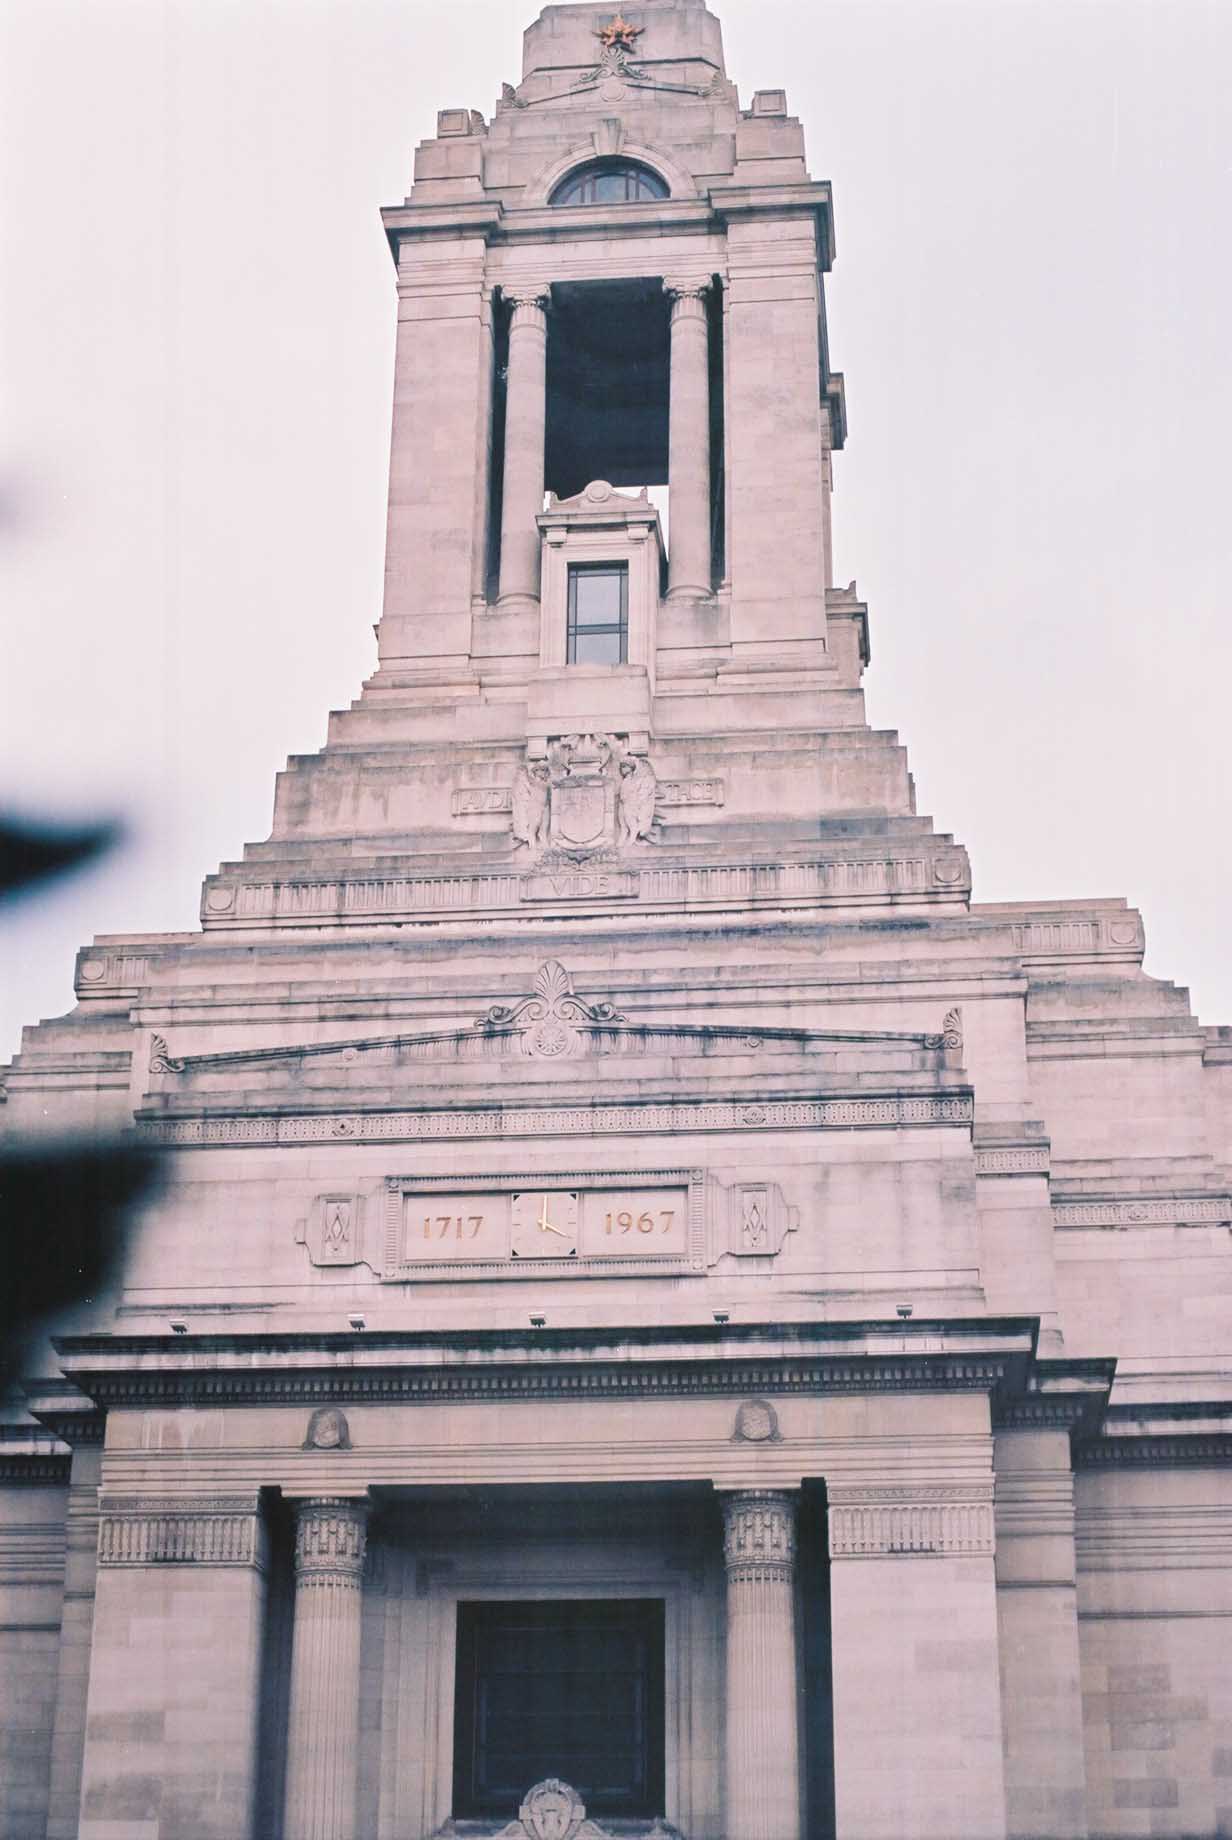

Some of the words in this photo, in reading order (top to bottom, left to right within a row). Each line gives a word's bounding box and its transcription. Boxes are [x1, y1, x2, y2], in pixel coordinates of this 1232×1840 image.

[549, 877, 609, 896] VIDE
[423, 1215, 484, 1240] 1717
[605, 1210, 675, 1235] 1967
